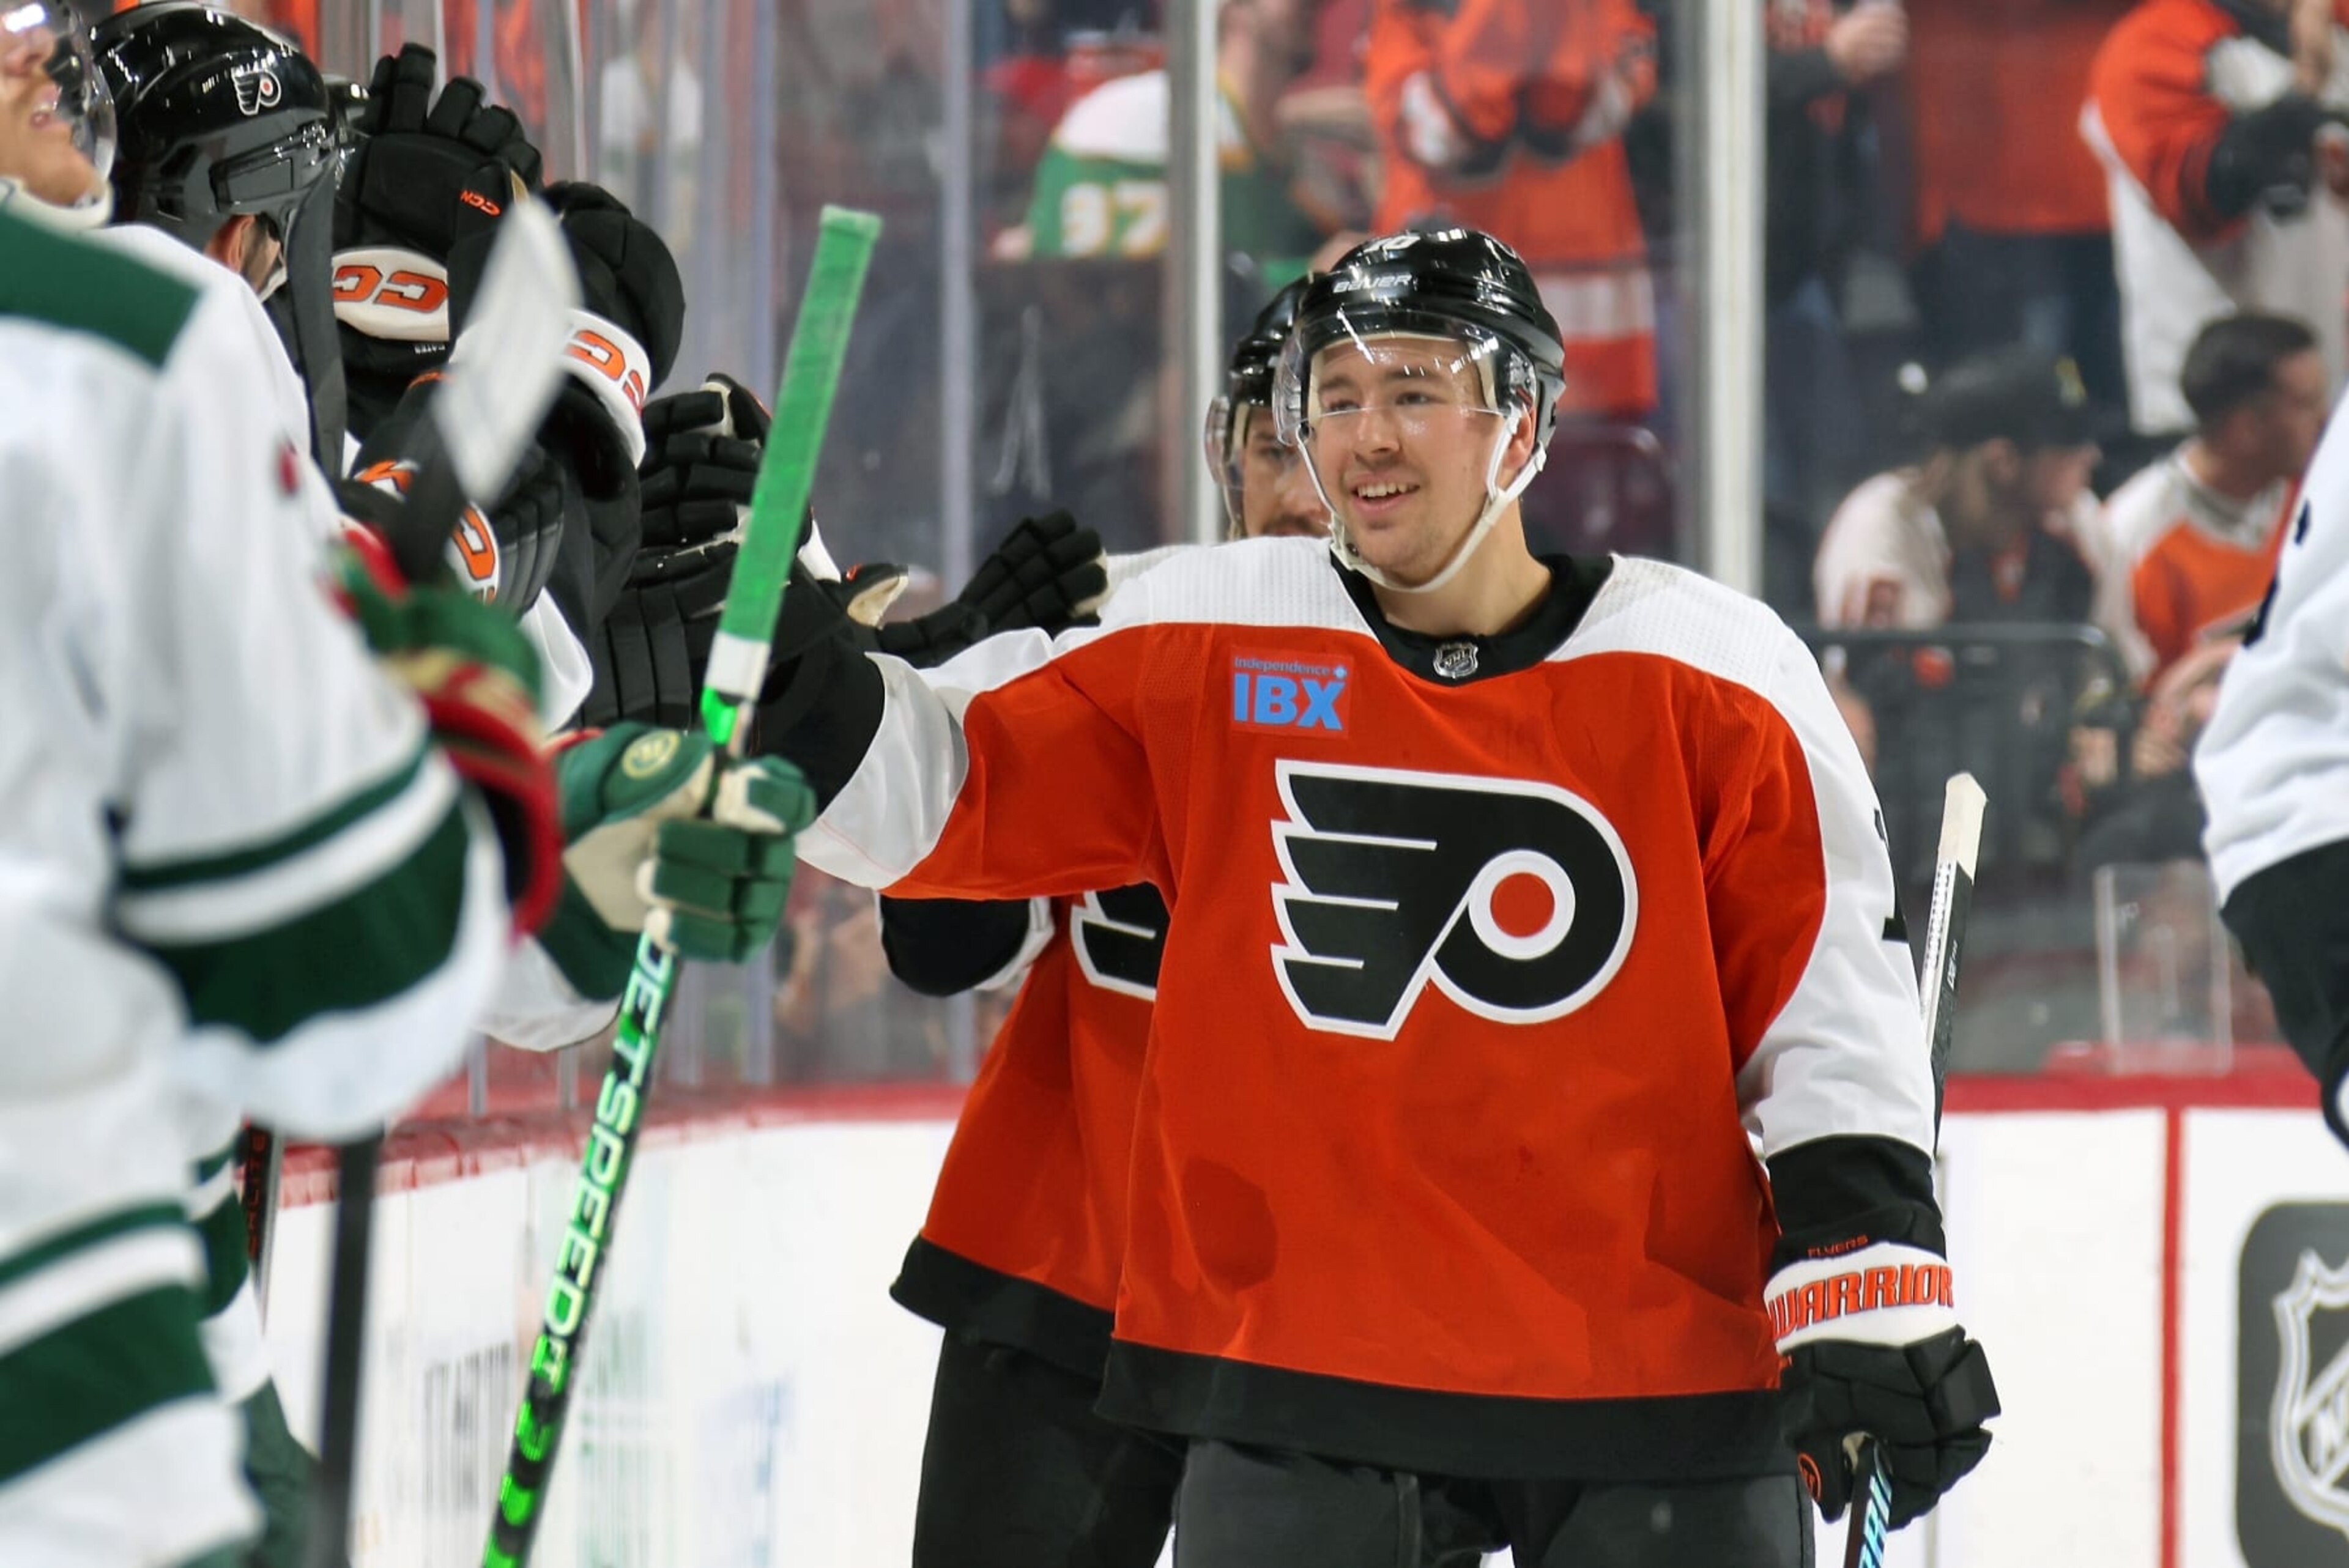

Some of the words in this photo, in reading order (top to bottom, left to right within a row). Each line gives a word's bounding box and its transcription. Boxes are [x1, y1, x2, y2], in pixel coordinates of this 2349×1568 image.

[1234, 657, 1330, 675] Independence
[1234, 672, 1345, 731] IBX
[1808, 1234, 1868, 1258] FLYERS
[1767, 1263, 1954, 1341] WARRIOR
